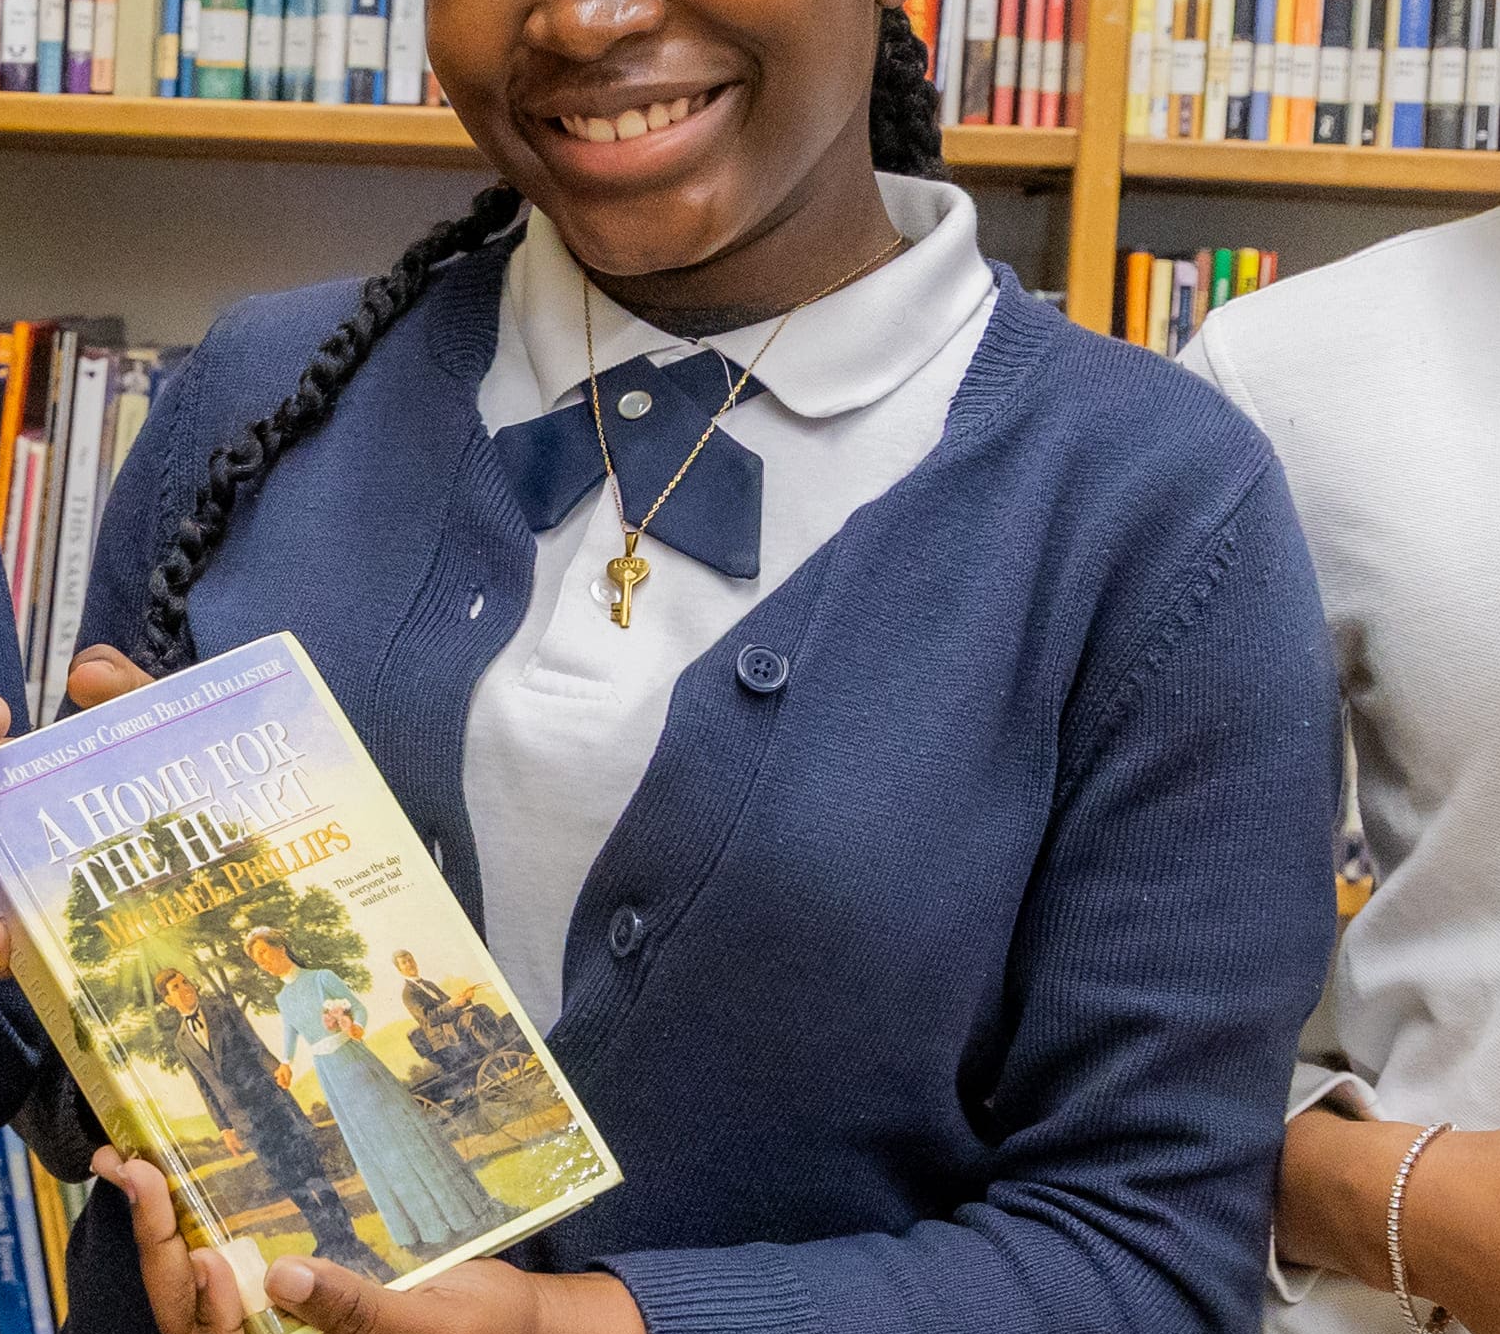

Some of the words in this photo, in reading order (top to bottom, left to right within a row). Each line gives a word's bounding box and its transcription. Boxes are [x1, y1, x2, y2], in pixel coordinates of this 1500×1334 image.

[3, 745, 79, 785] JOURNALS
[78, 737, 97, 755] OF
[96, 711, 155, 745] CORRIE
[152, 693, 202, 724] BELLE
[202, 658, 288, 703] HOLLISTER
[36, 805, 85, 865] A
[67, 753, 213, 839] HOME
[204, 718, 308, 789] FOR
[65, 833, 173, 912] THE
[160, 764, 321, 867] HEART
[95, 867, 227, 953] MICHAEL
[218, 820, 354, 898] PHILLIPS
[333, 875, 355, 890] This
[354, 867, 371, 882] was
[369, 858, 386, 875] the
[386, 853, 402, 871] day
[348, 876, 387, 899] everyone
[386, 866, 403, 882] had
[360, 889, 388, 908] waited
